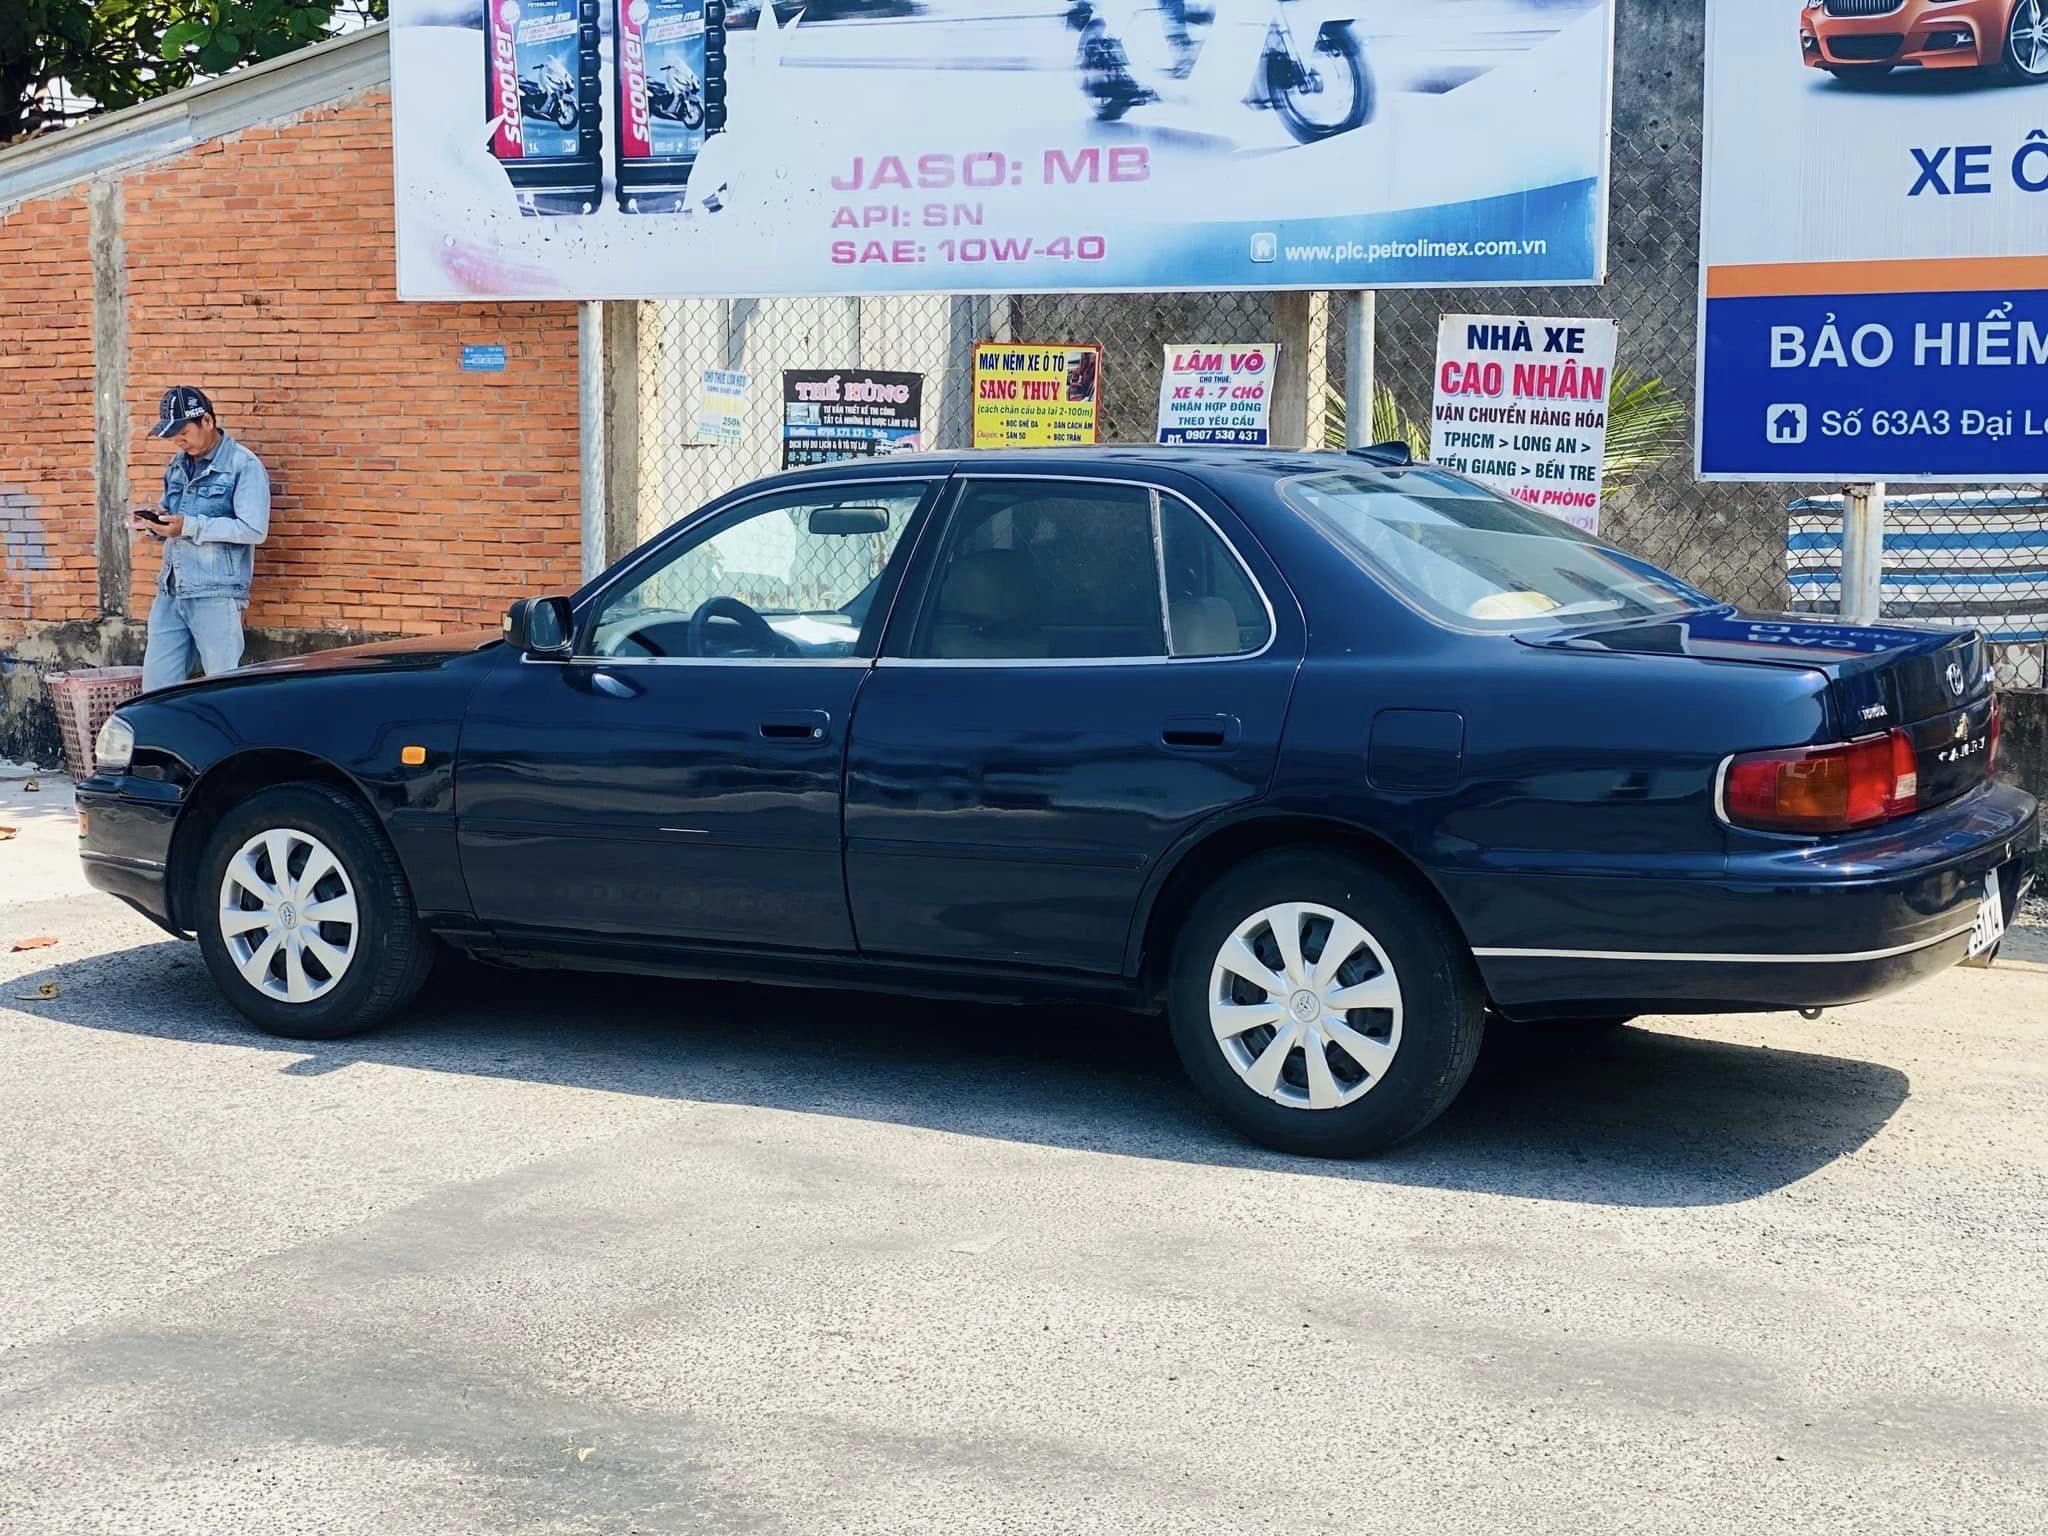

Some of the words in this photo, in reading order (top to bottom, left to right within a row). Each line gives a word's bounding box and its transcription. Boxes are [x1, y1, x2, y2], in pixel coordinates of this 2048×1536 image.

[495, 23, 521, 145] scooter
[624, 26, 649, 143] scooter
[831, 151, 1023, 191] JASO:
[1043, 146, 1151, 184] MB
[1907, 145, 1993, 196] XE
[830, 204, 910, 229] API:
[922, 202, 984, 227] SN
[831, 240, 926, 264] SAE:
[937, 235, 1106, 263] 10W-40
[1285, 238, 1547, 264] www.plc.petrolimex.com.vn
[1467, 321, 1533, 352] NHÀ
[1543, 327, 1585, 353] XE
[1770, 313, 1895, 368] BẢO
[979, 353, 1000, 370] MAY
[1003, 350, 1025, 374] NỆM
[1027, 354, 1040, 371] XE
[1043, 351, 1051, 371] Ô
[1053, 351, 1065, 372] TÔ
[1172, 349, 1223, 372] LÂM
[1230, 349, 1264, 373] VÕ
[795, 375, 841, 401] THẾ
[844, 378, 910, 404] HÙNG
[979, 380, 1017, 399] SANG
[1172, 386, 1192, 399] XE
[1194, 386, 1205, 399] 4
[1217, 386, 1229, 399] 7
[1231, 381, 1264, 399] CHỖ
[1200, 376, 1213, 384] CHO
[1440, 361, 1502, 395] CAO
[1513, 359, 1605, 400] NHÂN
[1171, 402, 1202, 413] NHẬN
[1205, 402, 1227, 413] HỢP
[1230, 400, 1262, 412] ĐỒNG
[1435, 404, 1464, 424] VẬN
[1469, 402, 1525, 424] CHUYỂN
[1530, 409, 1570, 427] HÀNG
[1575, 410, 1604, 428] HÓA
[1178, 416, 1205, 426] THEO
[1209, 415, 1229, 426] YÊU
[1232, 414, 1255, 426] CẦU
[1821, 407, 1865, 437] Số
[1872, 409, 1951, 436] 63A3
[1960, 409, 2012, 440] Đại
[2024, 409, 2048, 436] L
[1186, 430, 1212, 440] 0907
[1215, 430, 1235, 440] 530
[1239, 431, 1259, 441] 431
[1444, 432, 1494, 449] TPHCM
[1514, 435, 1551, 452] LONG
[1555, 437, 1576, 453] AN
[1471, 459, 1516, 476] GIANG
[1535, 459, 1565, 480] BẾN
[1570, 465, 1596, 482] TRE
[1511, 485, 1540, 503] VĂN
[1542, 488, 1597, 508] PHÒNG
